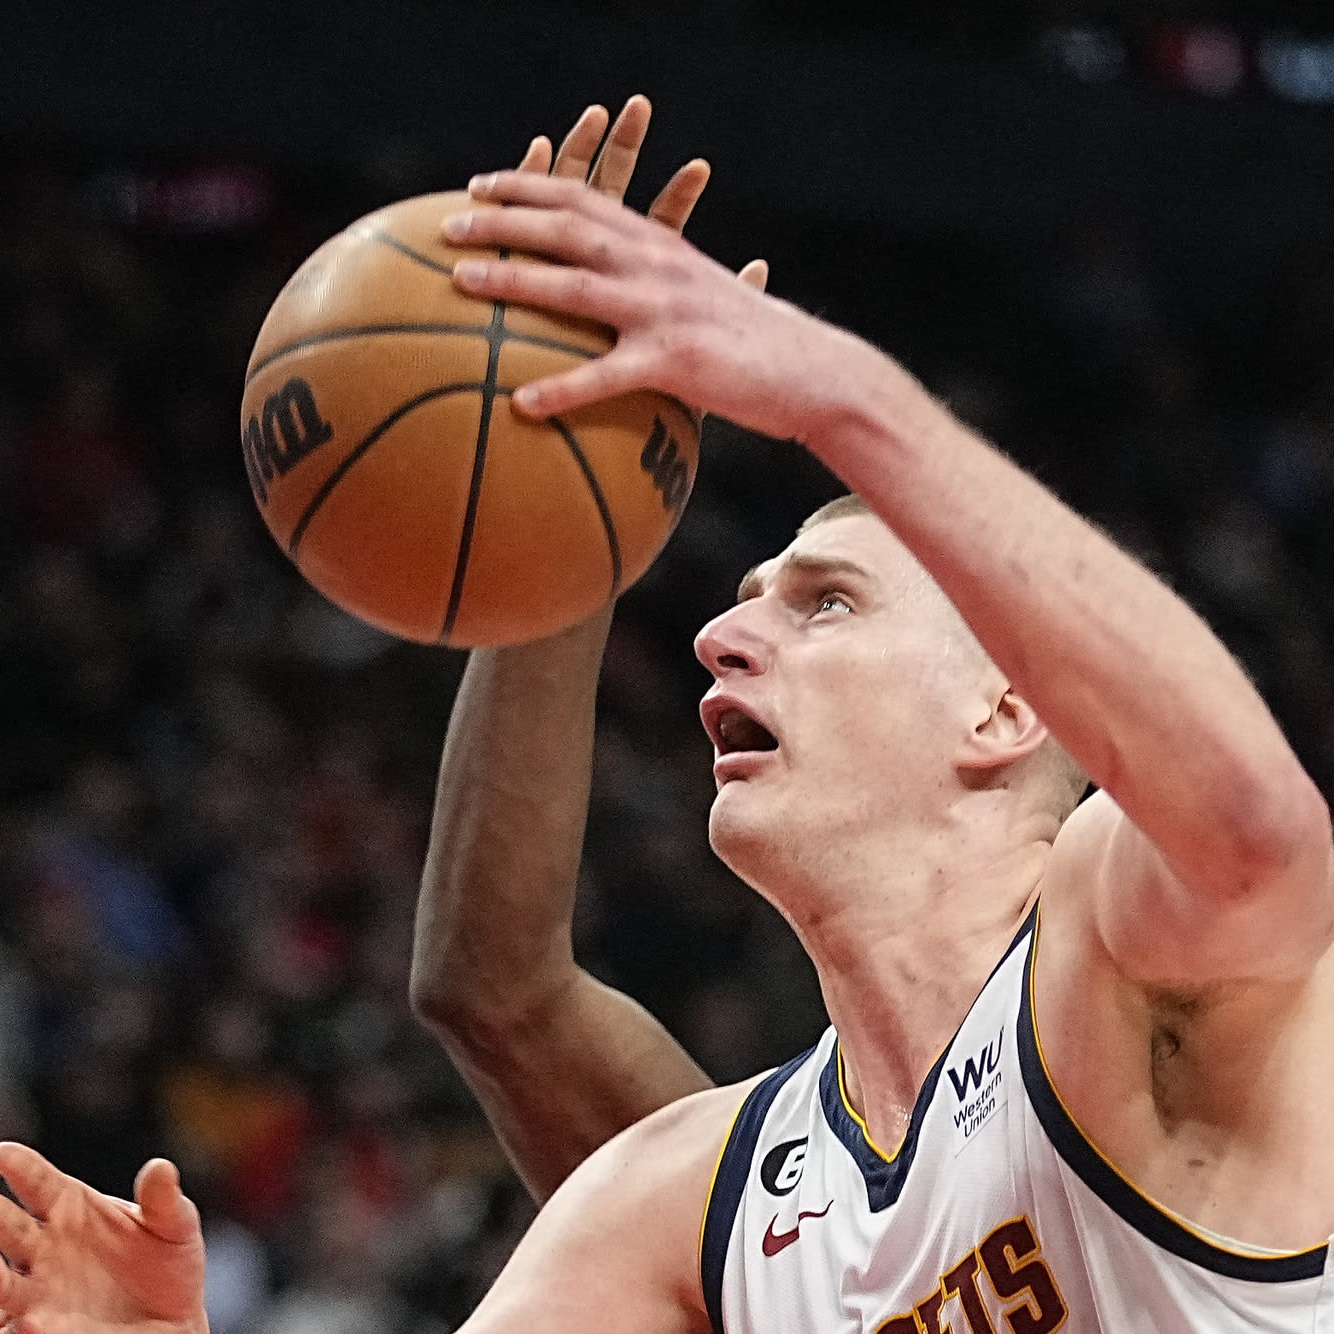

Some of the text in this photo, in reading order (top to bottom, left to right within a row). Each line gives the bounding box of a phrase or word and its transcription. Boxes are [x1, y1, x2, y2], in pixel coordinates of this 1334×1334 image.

[947, 1025, 1005, 1102] WU
[953, 1071, 1002, 1129] Western
[964, 1097, 996, 1138] Union
